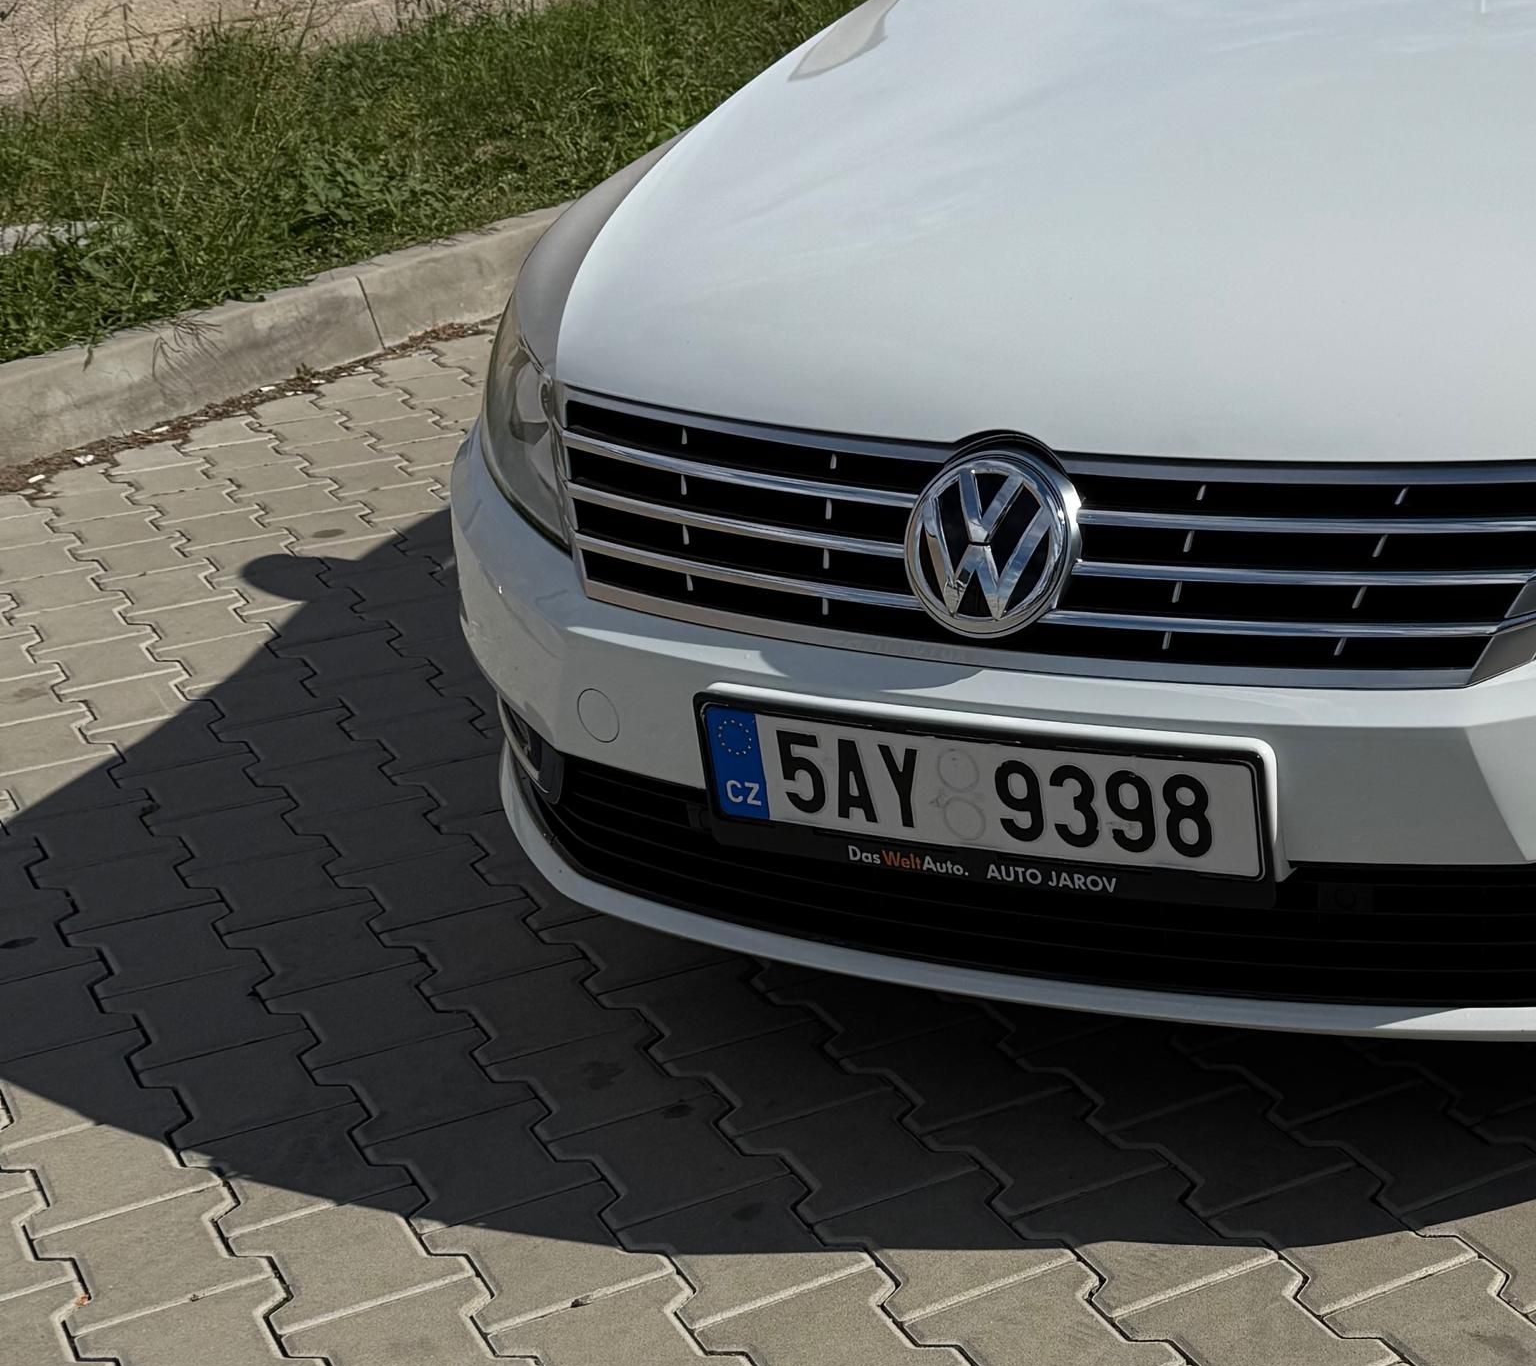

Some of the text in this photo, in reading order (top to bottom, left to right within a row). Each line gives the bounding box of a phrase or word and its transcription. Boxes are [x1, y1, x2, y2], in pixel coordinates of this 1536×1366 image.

[726, 780, 762, 806] CZ
[776, 729, 1213, 858] 5AY 9398
[986, 864, 1117, 893] AUTO JAROV
